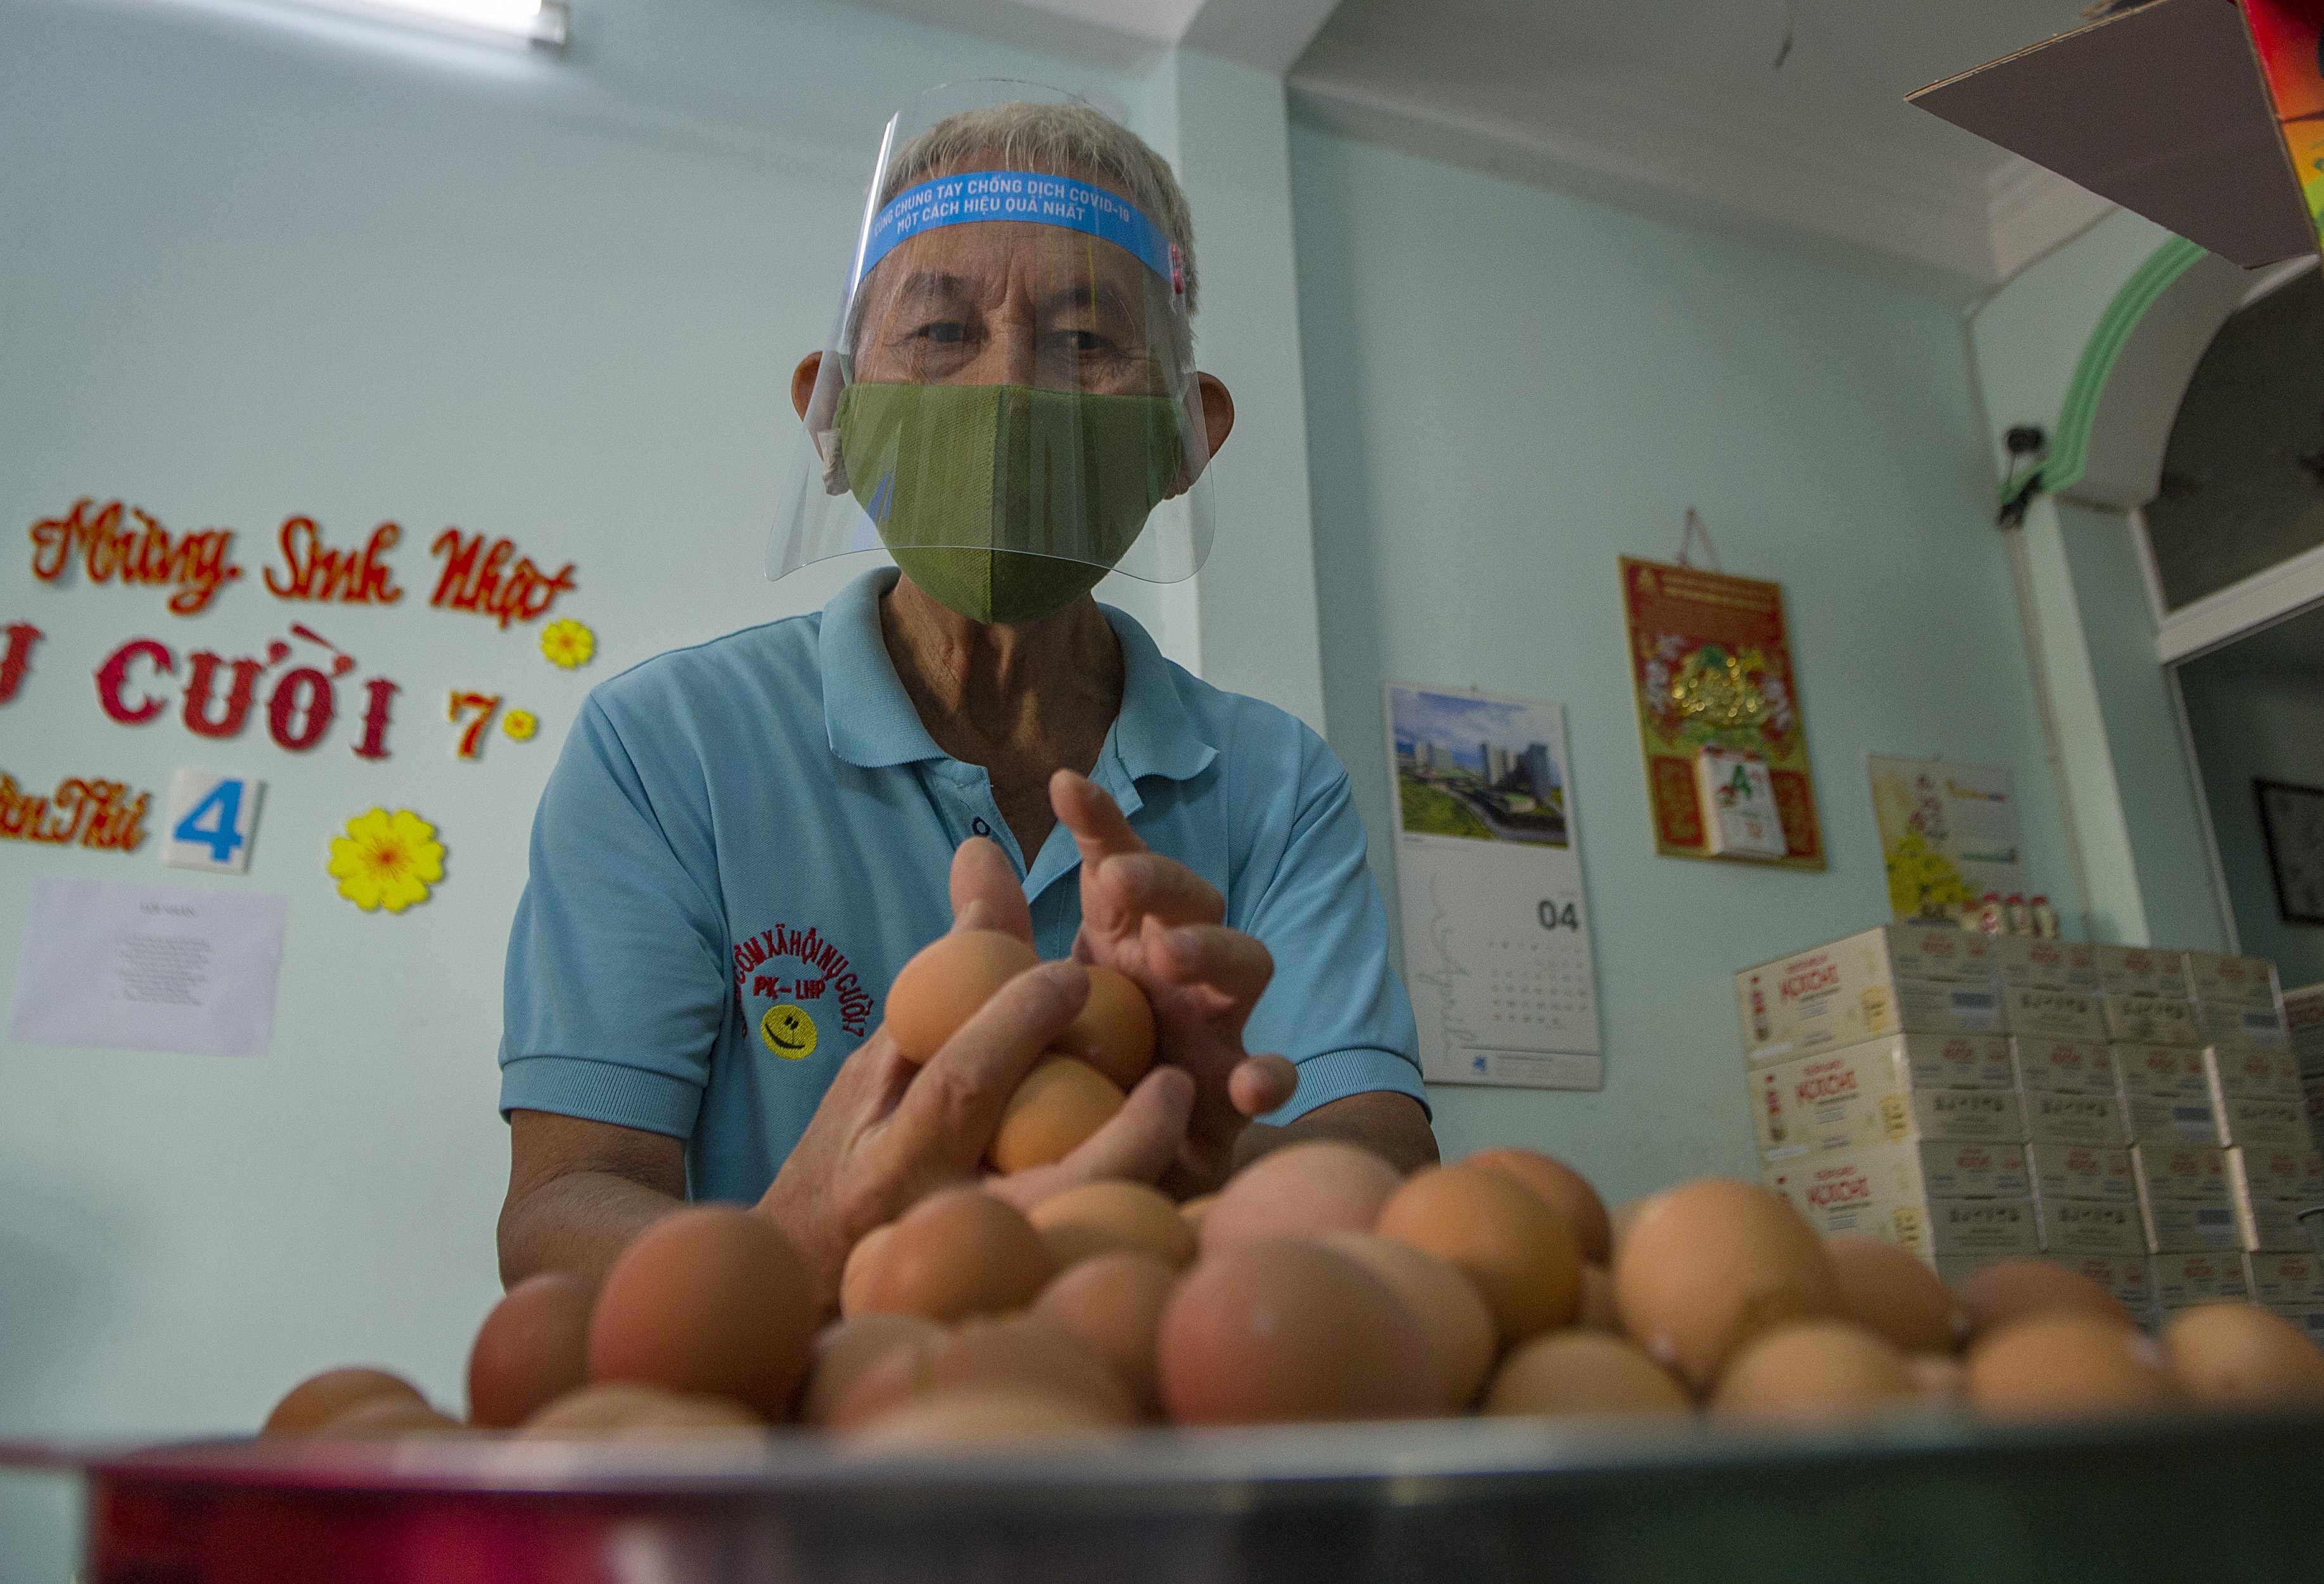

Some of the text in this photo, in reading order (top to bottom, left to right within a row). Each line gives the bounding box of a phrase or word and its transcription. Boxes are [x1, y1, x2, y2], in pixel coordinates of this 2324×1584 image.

[895, 189, 932, 217] CHUNG
[937, 181, 963, 199] TAY
[968, 175, 1022, 195] CHỐNG
[1028, 181, 1064, 198] DỊCH
[1069, 188, 1130, 222] COVID-19
[897, 195, 1085, 234] MỘT CÁCH HIỆU QUẢ NHẤT
[94, 623, 400, 760] CƯỜI
[448, 689, 500, 758] 7
[174, 778, 245, 863] 4
[1538, 898, 1579, 931] 04
[761, 923, 788, 958] XÃ
